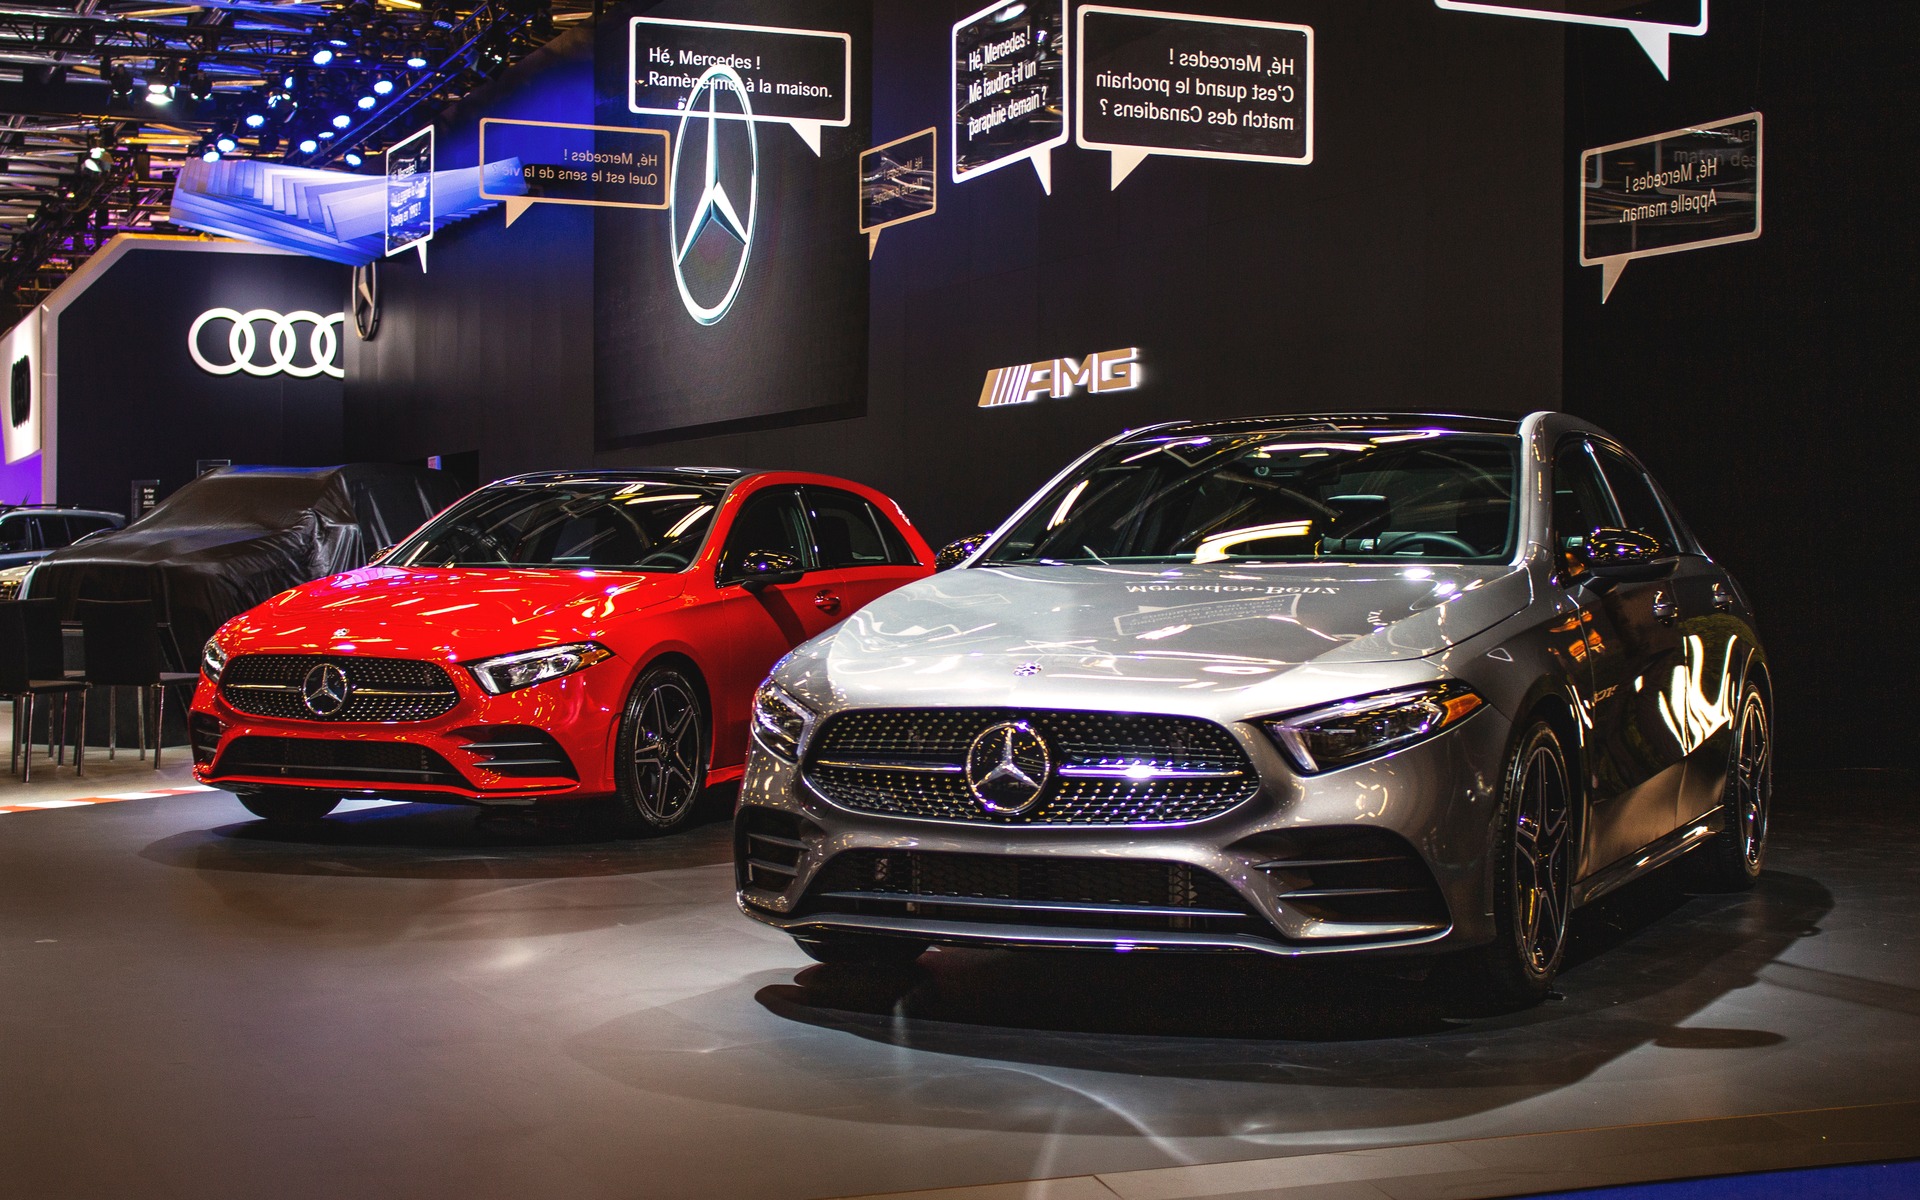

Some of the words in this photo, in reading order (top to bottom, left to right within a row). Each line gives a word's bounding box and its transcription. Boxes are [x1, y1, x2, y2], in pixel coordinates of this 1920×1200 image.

[649, 47, 674, 67] Hé,
[679, 50, 752, 70] Mercedes
[756, 56, 761, 71] !
[969, 49, 983, 72] Hé,
[984, 32, 1026, 65] Mercedes
[649, 71, 742, 92] Ramène-mo
[759, 79, 772, 95] la
[776, 81, 833, 98] maison.
[1025, 61, 1036, 80] un
[968, 105, 1007, 142] parapluie
[1008, 90, 1040, 120] demain
[1021, 347, 1142, 400] AMG
